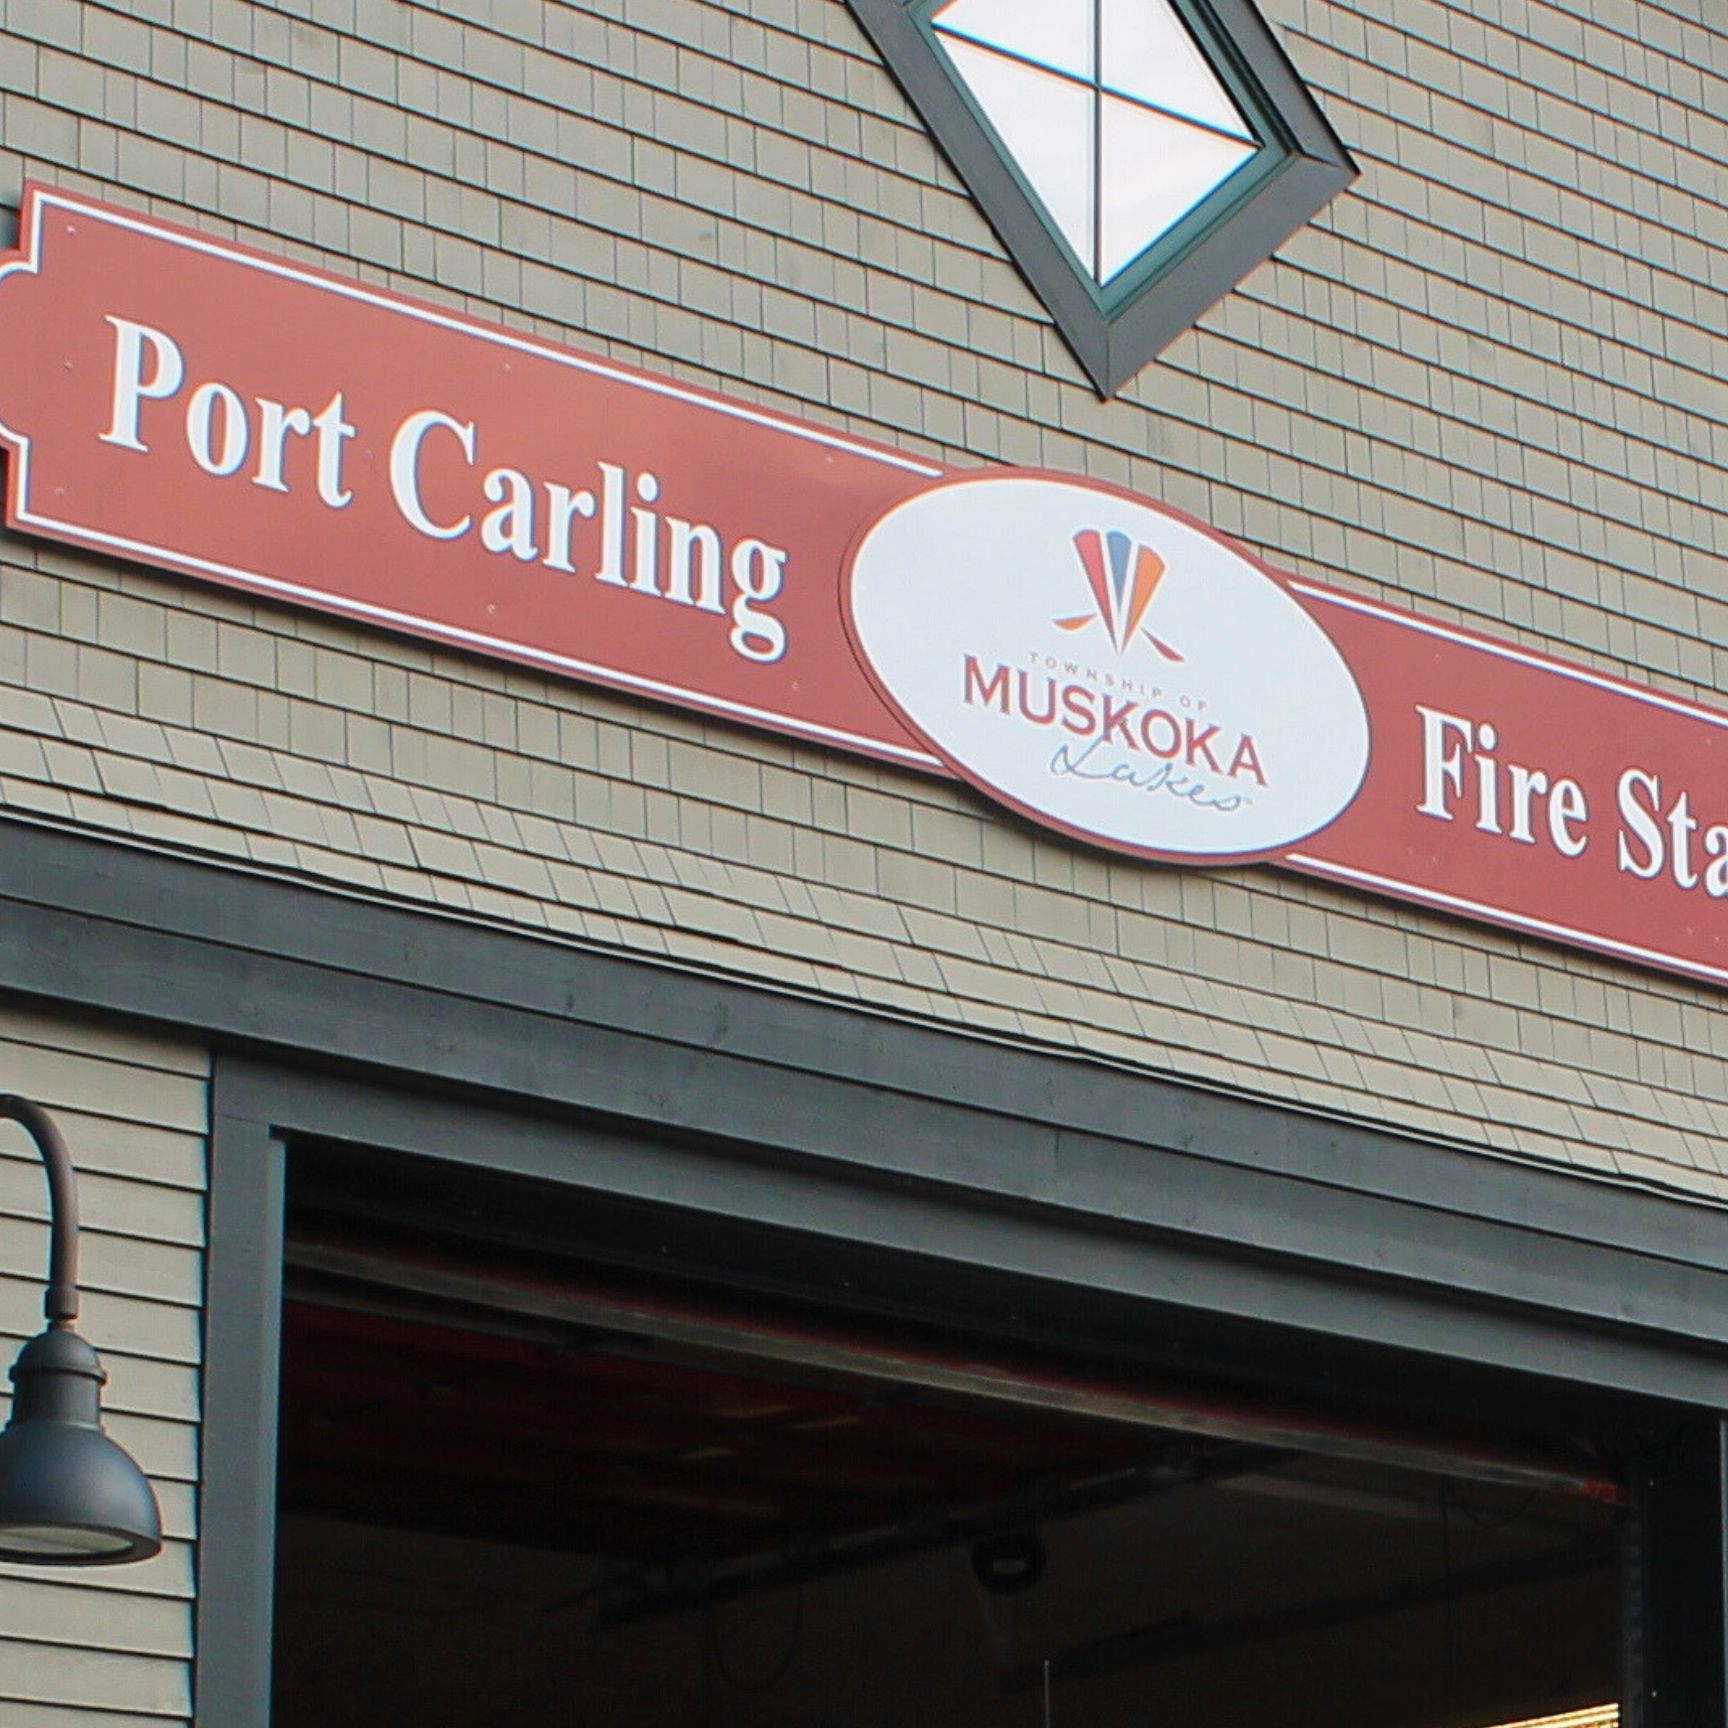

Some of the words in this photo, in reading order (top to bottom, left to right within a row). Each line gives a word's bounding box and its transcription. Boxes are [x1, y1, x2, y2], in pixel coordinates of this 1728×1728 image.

[97, 314, 356, 508] Port
[389, 409, 788, 663] Carling
[962, 653, 1268, 787] MUSKOKA
[1028, 651, 1163, 699] TOWNSHIP
[1179, 695, 1207, 712] OF
[1050, 726, 1243, 812] Lakes
[1415, 704, 1589, 857] Fire
